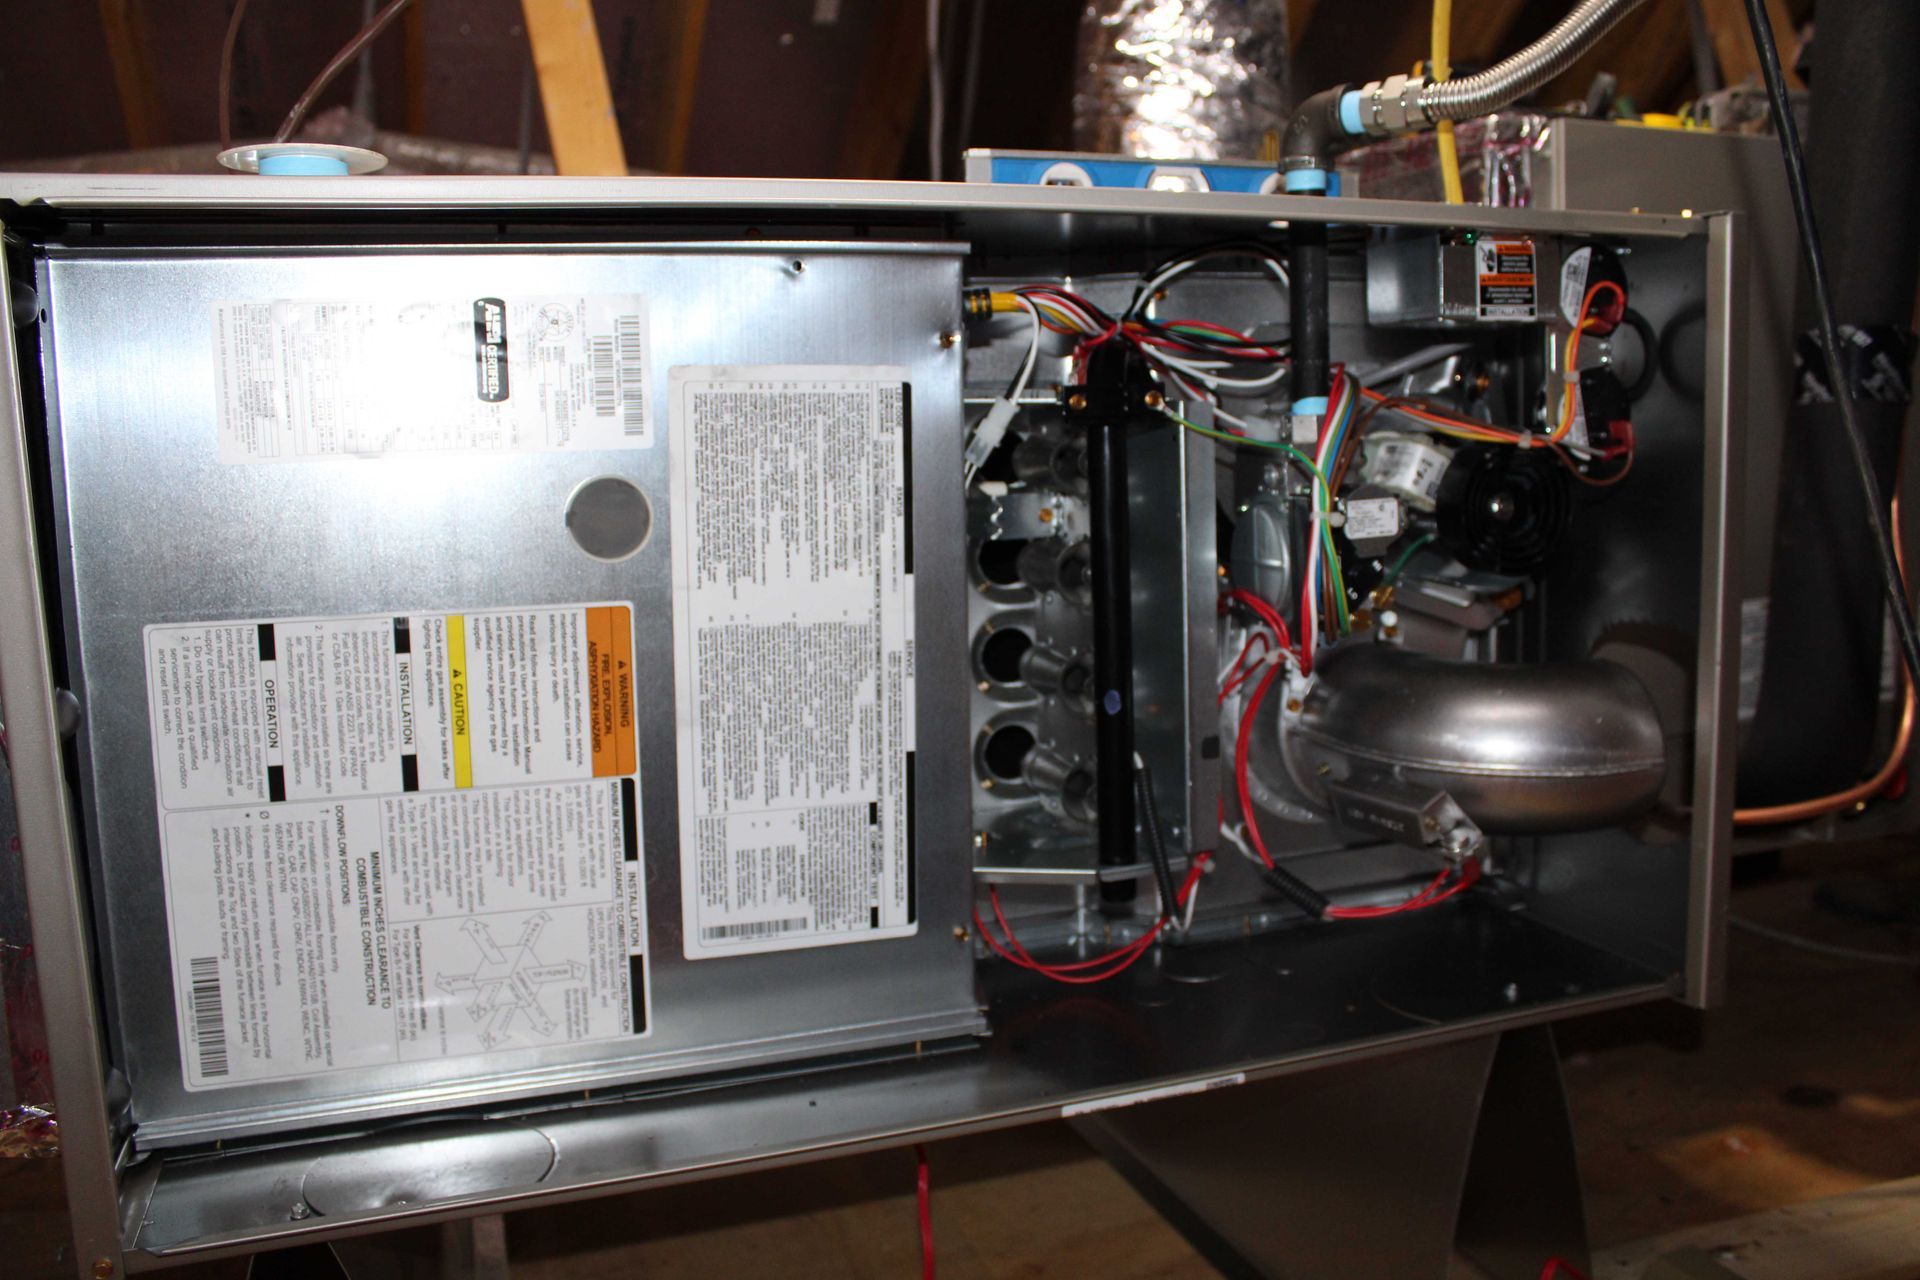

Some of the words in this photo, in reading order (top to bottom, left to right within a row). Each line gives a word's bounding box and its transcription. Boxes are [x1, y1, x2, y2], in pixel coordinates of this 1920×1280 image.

[895, 486, 903, 517] STATUS
[214, 628, 222, 644] can
[235, 627, 244, 645] limit
[245, 627, 255, 645] This
[421, 619, 432, 649] lighting
[433, 618, 443, 643] Check
[482, 616, 493, 651] qualified
[494, 616, 503, 632] and
[505, 615, 515, 651] provided
[527, 614, 536, 635] Read
[548, 613, 557, 644] serious
[568, 612, 579, 649] Improper
[193, 645, 203, 658] Do
[202, 628, 213, 656] supply
[223, 627, 234, 656] protect
[495, 632, 504, 662] service
[516, 615, 526, 662] precautions
[528, 636, 537, 652] and
[157, 647, 166, 664] and
[194, 659, 203, 673] not
[206, 657, 213, 667] or
[215, 645, 225, 669] result
[235, 645, 247, 688] switch(es)
[246, 646, 257, 678] furnace
[424, 650, 433, 666] this
[435, 645, 443, 669] entire
[485, 652, 494, 681] service
[508, 652, 516, 669] with
[520, 663, 526, 671] in
[529, 653, 538, 678] follow
[548, 644, 557, 667] injury
[905, 639, 914, 677] SERVICE
[158, 666, 168, 688] reset
[169, 647, 180, 695] serviceman
[182, 661, 192, 679] limit
[217, 670, 227, 690] from
[225, 658, 236, 688] against
[248, 679, 255, 687] is
[434, 670, 443, 685] gas
[497, 663, 505, 684] must
[508, 670, 516, 686] this
[551, 668, 557, 678] or
[561, 667, 568, 676] or
[588, 640, 599, 711] ASPHYXIATION
[160, 688, 170, 706] limit
[194, 675, 206, 705] bypass
[206, 668, 217, 701] blocked
[240, 689, 246, 697] in
[485, 683, 495, 712] agency
[498, 685, 506, 695] be
[519, 672, 528, 698] User's
[562, 677, 571, 720] installation
[173, 696, 181, 705] to
[209, 702, 218, 721] vent
[217, 691, 230, 737] inadequate
[228, 689, 239, 726] overheat
[239, 698, 250, 726] burner
[248, 688, 260, 726] equipped
[263, 679, 279, 748] OPERATION
[397, 662, 413, 745] INSTALLATION
[435, 686, 447, 725] assembly
[452, 682, 466, 735] CAUTION
[531, 679, 540, 726] instructions
[618, 673, 629, 728] WARNING
[173, 706, 184, 735] correct
[186, 710, 195, 725] call
[198, 706, 207, 724] limit
[488, 713, 495, 722] or
[497, 696, 508, 738] performed
[521, 699, 530, 744] Information
[176, 737, 185, 751] the
[252, 727, 261, 745] with
[439, 726, 448, 738] for
[489, 723, 497, 737] the
[500, 739, 508, 749] by
[533, 727, 541, 743] and
[591, 712, 601, 753] HAZARD
[187, 733, 199, 771] qualified
[231, 727, 243, 769] conditions
[241, 727, 254, 781] compartment
[440, 739, 449, 760] leaks
[488, 737, 497, 752] gas
[511, 723, 521, 766] Installation
[564, 737, 572, 761] cause
[177, 752, 188, 789] condition
[221, 737, 234, 785] combustion
[253, 746, 264, 777] manual
[441, 761, 450, 780] after
[523, 745, 532, 774] Manual
[226, 786, 234, 797] air
[235, 769, 244, 786] that
[245, 781, 254, 791] to
[255, 777, 264, 799] reset
[610, 781, 619, 817] MINIMUM
[334, 804, 347, 857] DOWNFLOW
[611, 818, 621, 849] INCHES
[369, 850, 382, 895] MINIMUM
[613, 850, 623, 898] CLEARANCE
[355, 857, 370, 927] COMBUSTIBLE
[870, 881, 878, 900] TEST
[372, 896, 385, 933] INCHES
[615, 901, 624, 913] TO
[627, 871, 639, 947] INSTALLATION
[616, 913, 626, 969] COMBUSTIBLE
[360, 929, 376, 1006] CONSTRUCTION
[375, 934, 390, 993] CLEARANCE
[380, 995, 391, 1009] TO
[619, 971, 630, 1032] CONSTRUCTION
